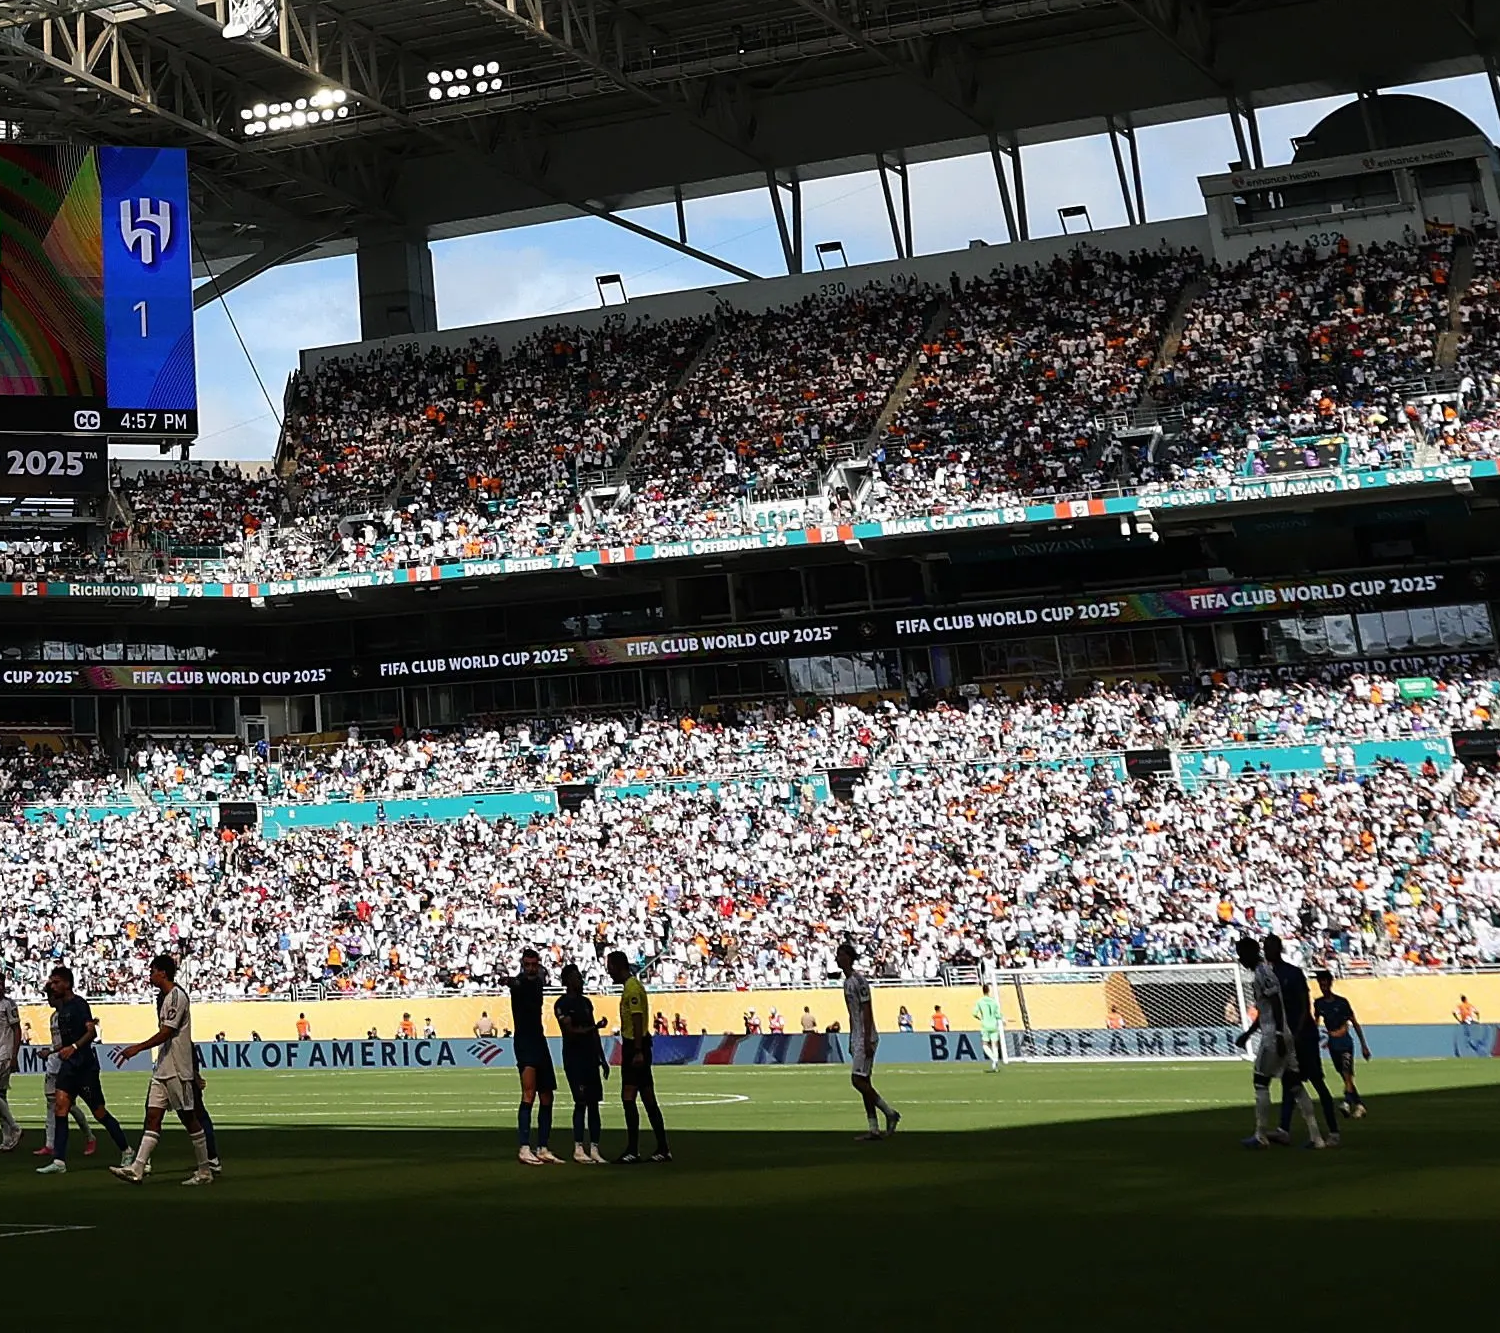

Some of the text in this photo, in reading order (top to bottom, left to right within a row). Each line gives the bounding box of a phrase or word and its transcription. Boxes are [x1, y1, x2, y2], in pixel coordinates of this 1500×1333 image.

[820, 282, 846, 298] 330
[133, 301, 148, 338] 1
[75, 412, 99, 428] CC
[120, 413, 187, 429] 4:57 PM
[881, 507, 1026, 535] MARK CLAYTON 83
[652, 533, 786, 558] JOHN OFFERDAHL 56
[464, 554, 574, 576] DOUG BETTERS 75
[70, 583, 203, 597] RICHMOND WEBB 78
[270, 571, 394, 595] BOB BAUMHOWER 73
[1190, 593, 1228, 609] FIFA
[1232, 589, 1276, 605] CLUB
[1279, 583, 1345, 602] WORLD
[1350, 580, 1385, 596] CUP
[195, 1040, 457, 1069] ANK OF AMERICA
